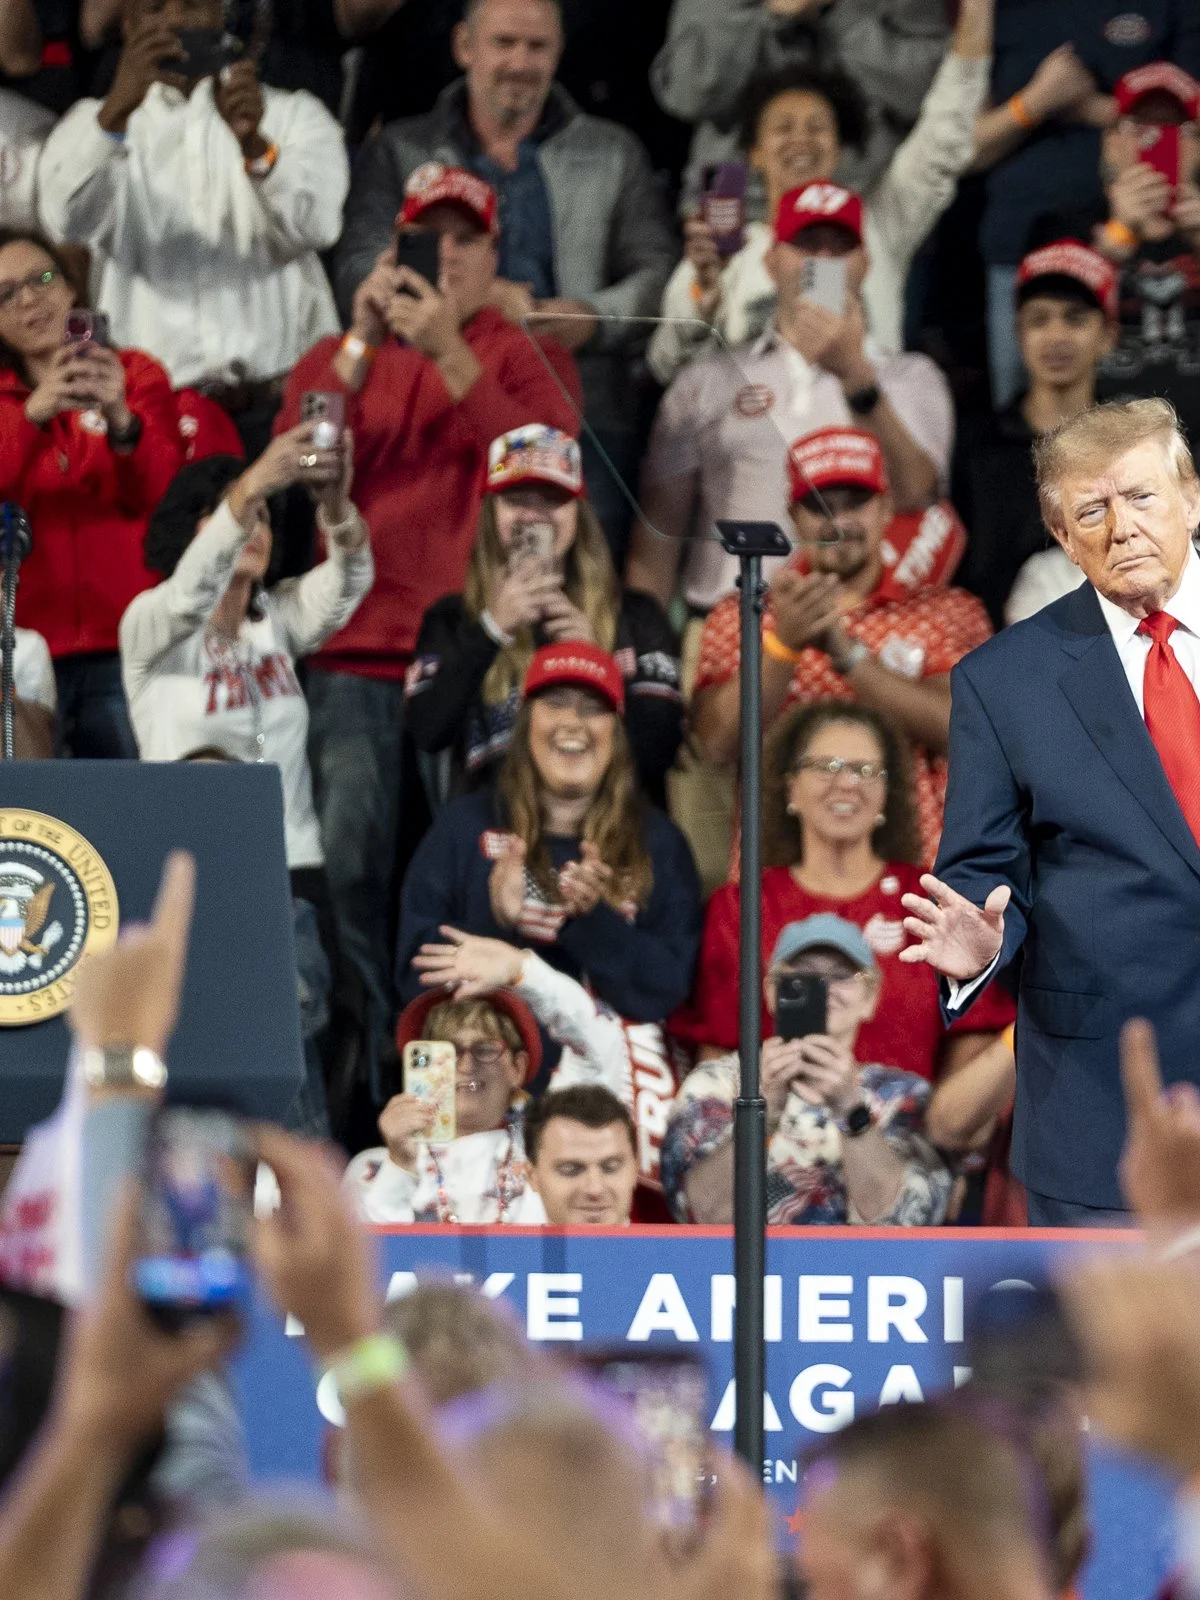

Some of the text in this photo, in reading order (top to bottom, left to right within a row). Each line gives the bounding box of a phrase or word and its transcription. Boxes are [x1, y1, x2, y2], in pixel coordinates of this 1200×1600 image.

[793, 183, 850, 215] 47
[14, 819, 31, 832] OF
[69, 843, 110, 930] UNITED
[627, 1273, 1036, 1343] AMERI
[690, 1363, 974, 1433] AGA
